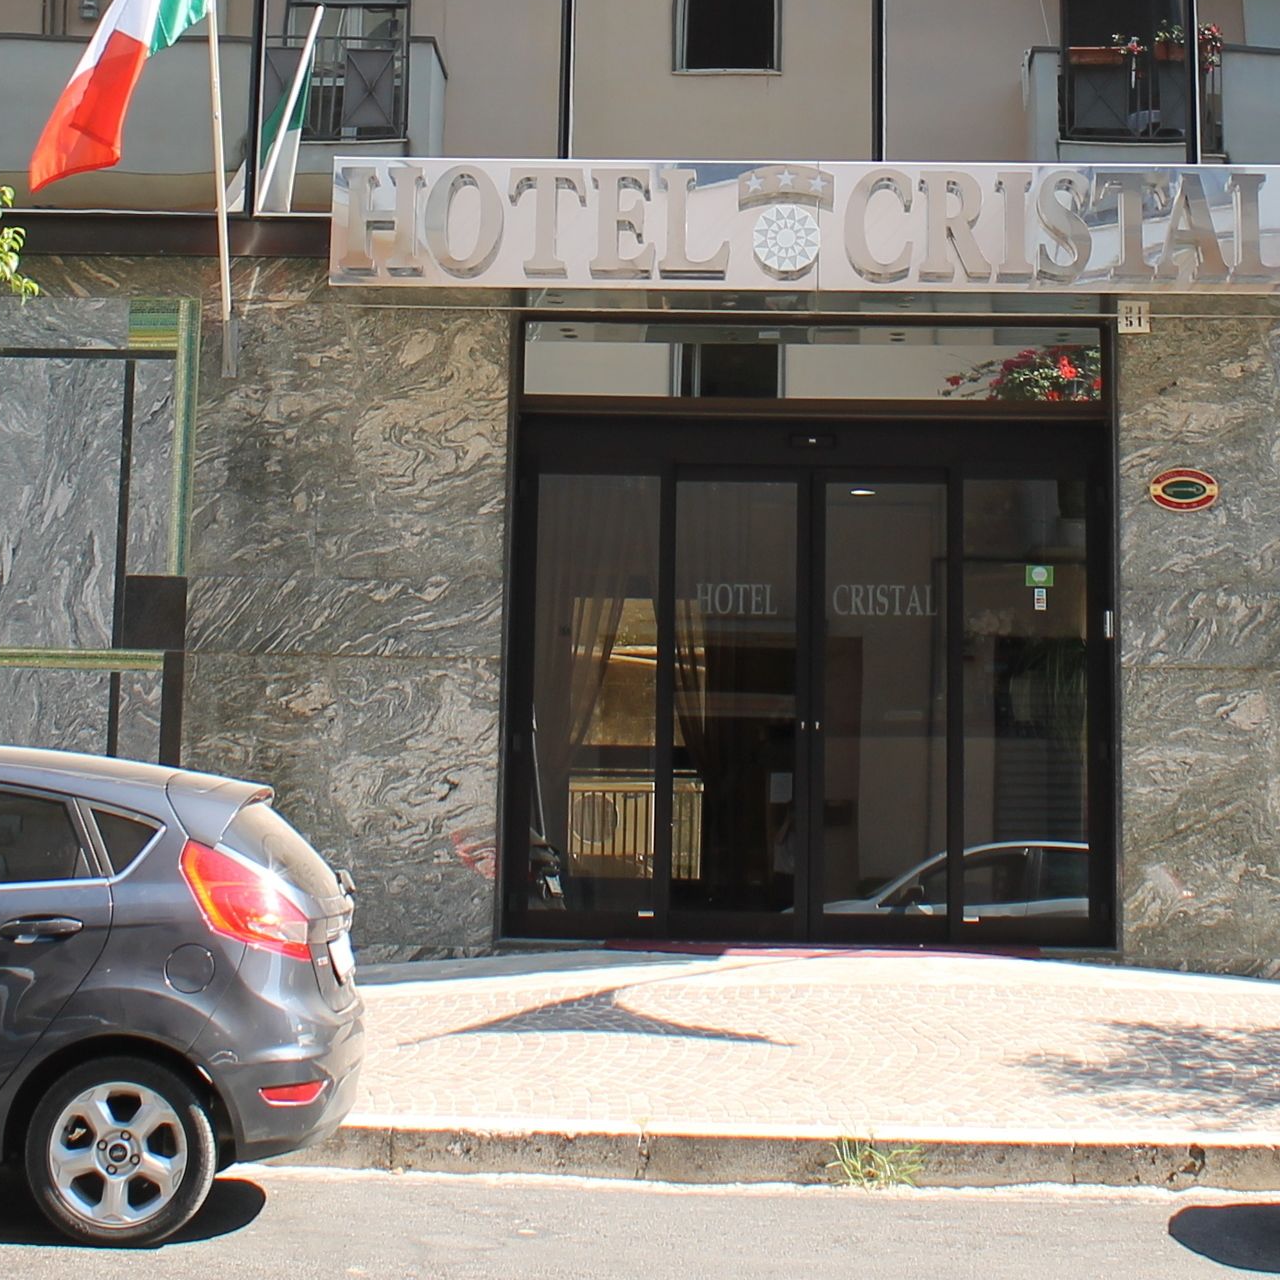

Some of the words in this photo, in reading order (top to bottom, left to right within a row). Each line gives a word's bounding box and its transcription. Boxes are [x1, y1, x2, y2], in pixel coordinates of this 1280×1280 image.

[339, 165, 730, 280] HOTEL
[696, 583, 778, 615] HOTEL
[832, 584, 938, 616] CRISTAL
